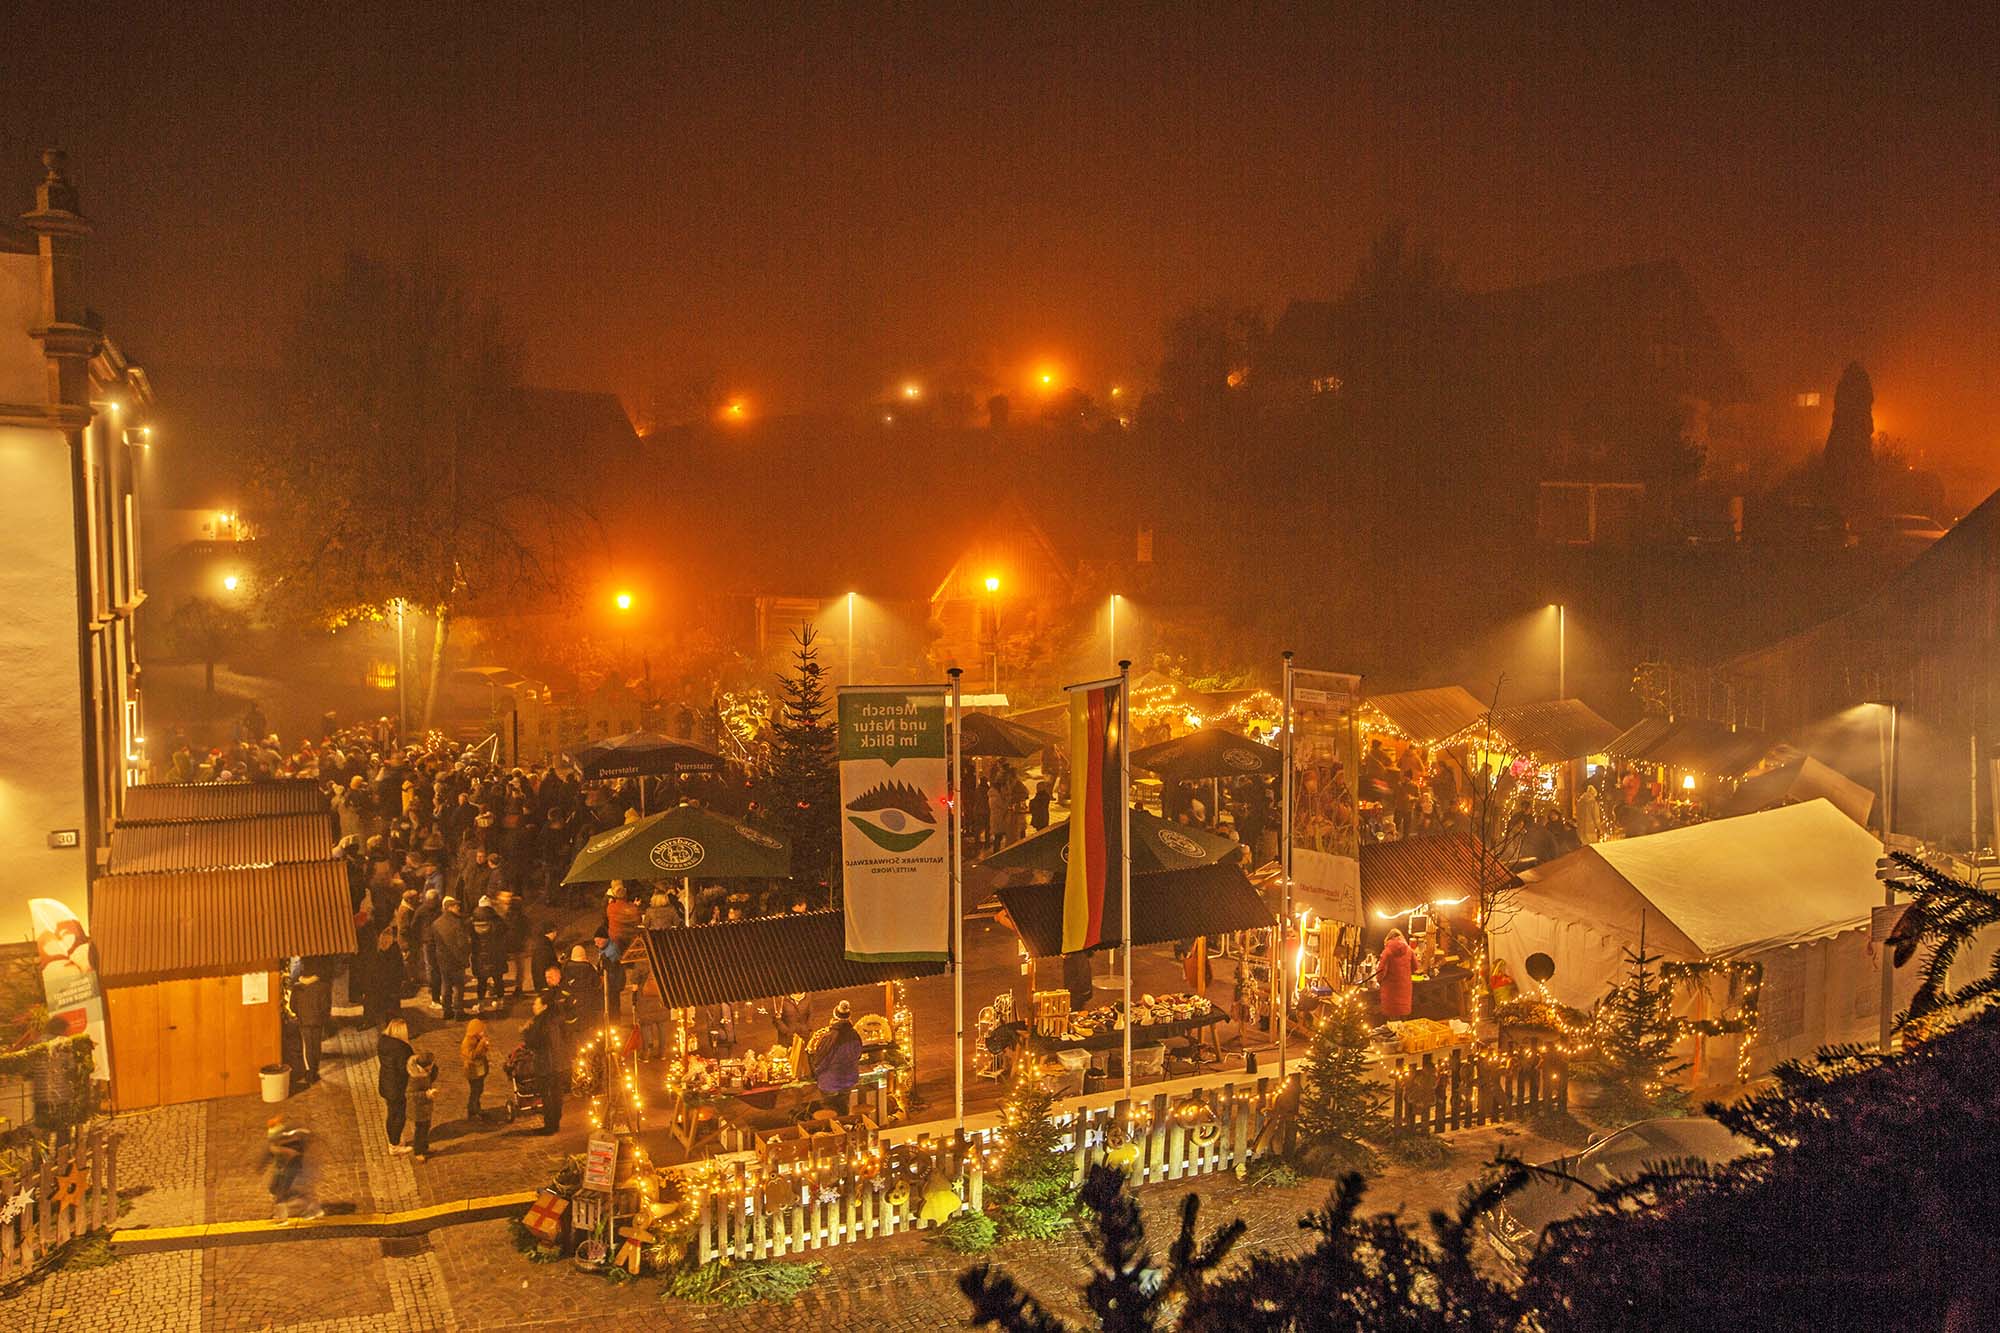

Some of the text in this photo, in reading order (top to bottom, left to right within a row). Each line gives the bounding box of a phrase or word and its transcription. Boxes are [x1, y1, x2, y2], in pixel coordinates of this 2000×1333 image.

[599, 766, 640, 777] Peterstaler
[58, 834, 73, 844] 30
[653, 838, 700, 856] Alpirsbacher
